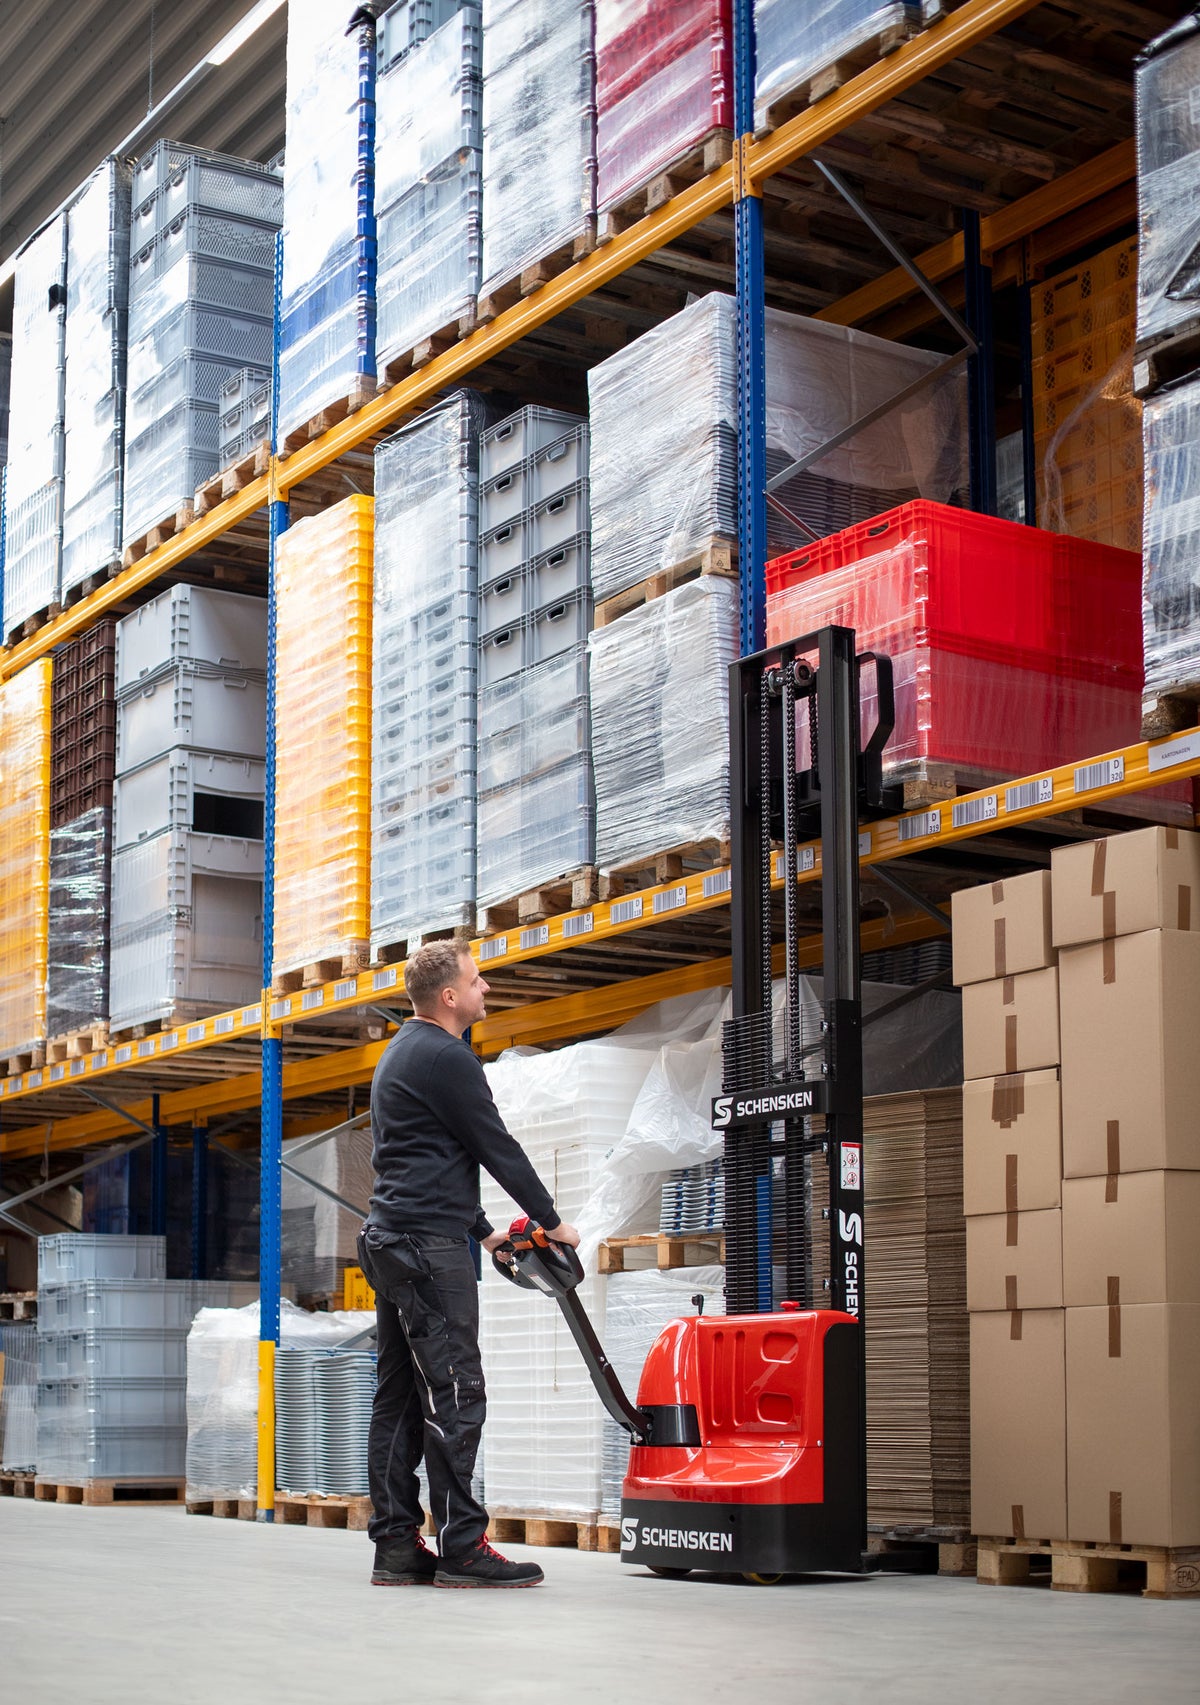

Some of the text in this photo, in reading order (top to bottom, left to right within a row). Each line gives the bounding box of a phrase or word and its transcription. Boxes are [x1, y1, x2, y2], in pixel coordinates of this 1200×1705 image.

[1113, 759, 1120, 769] D
[1111, 771, 1123, 782] 320
[1042, 779, 1049, 789] D
[987, 796, 993, 806] D
[1040, 791, 1052, 801] 220
[931, 813, 937, 822] D
[985, 808, 996, 818] 120
[929, 824, 940, 833] 319
[736, 1091, 813, 1117] SCHENSKEN
[641, 1526, 733, 1552] SCHENSKEN
